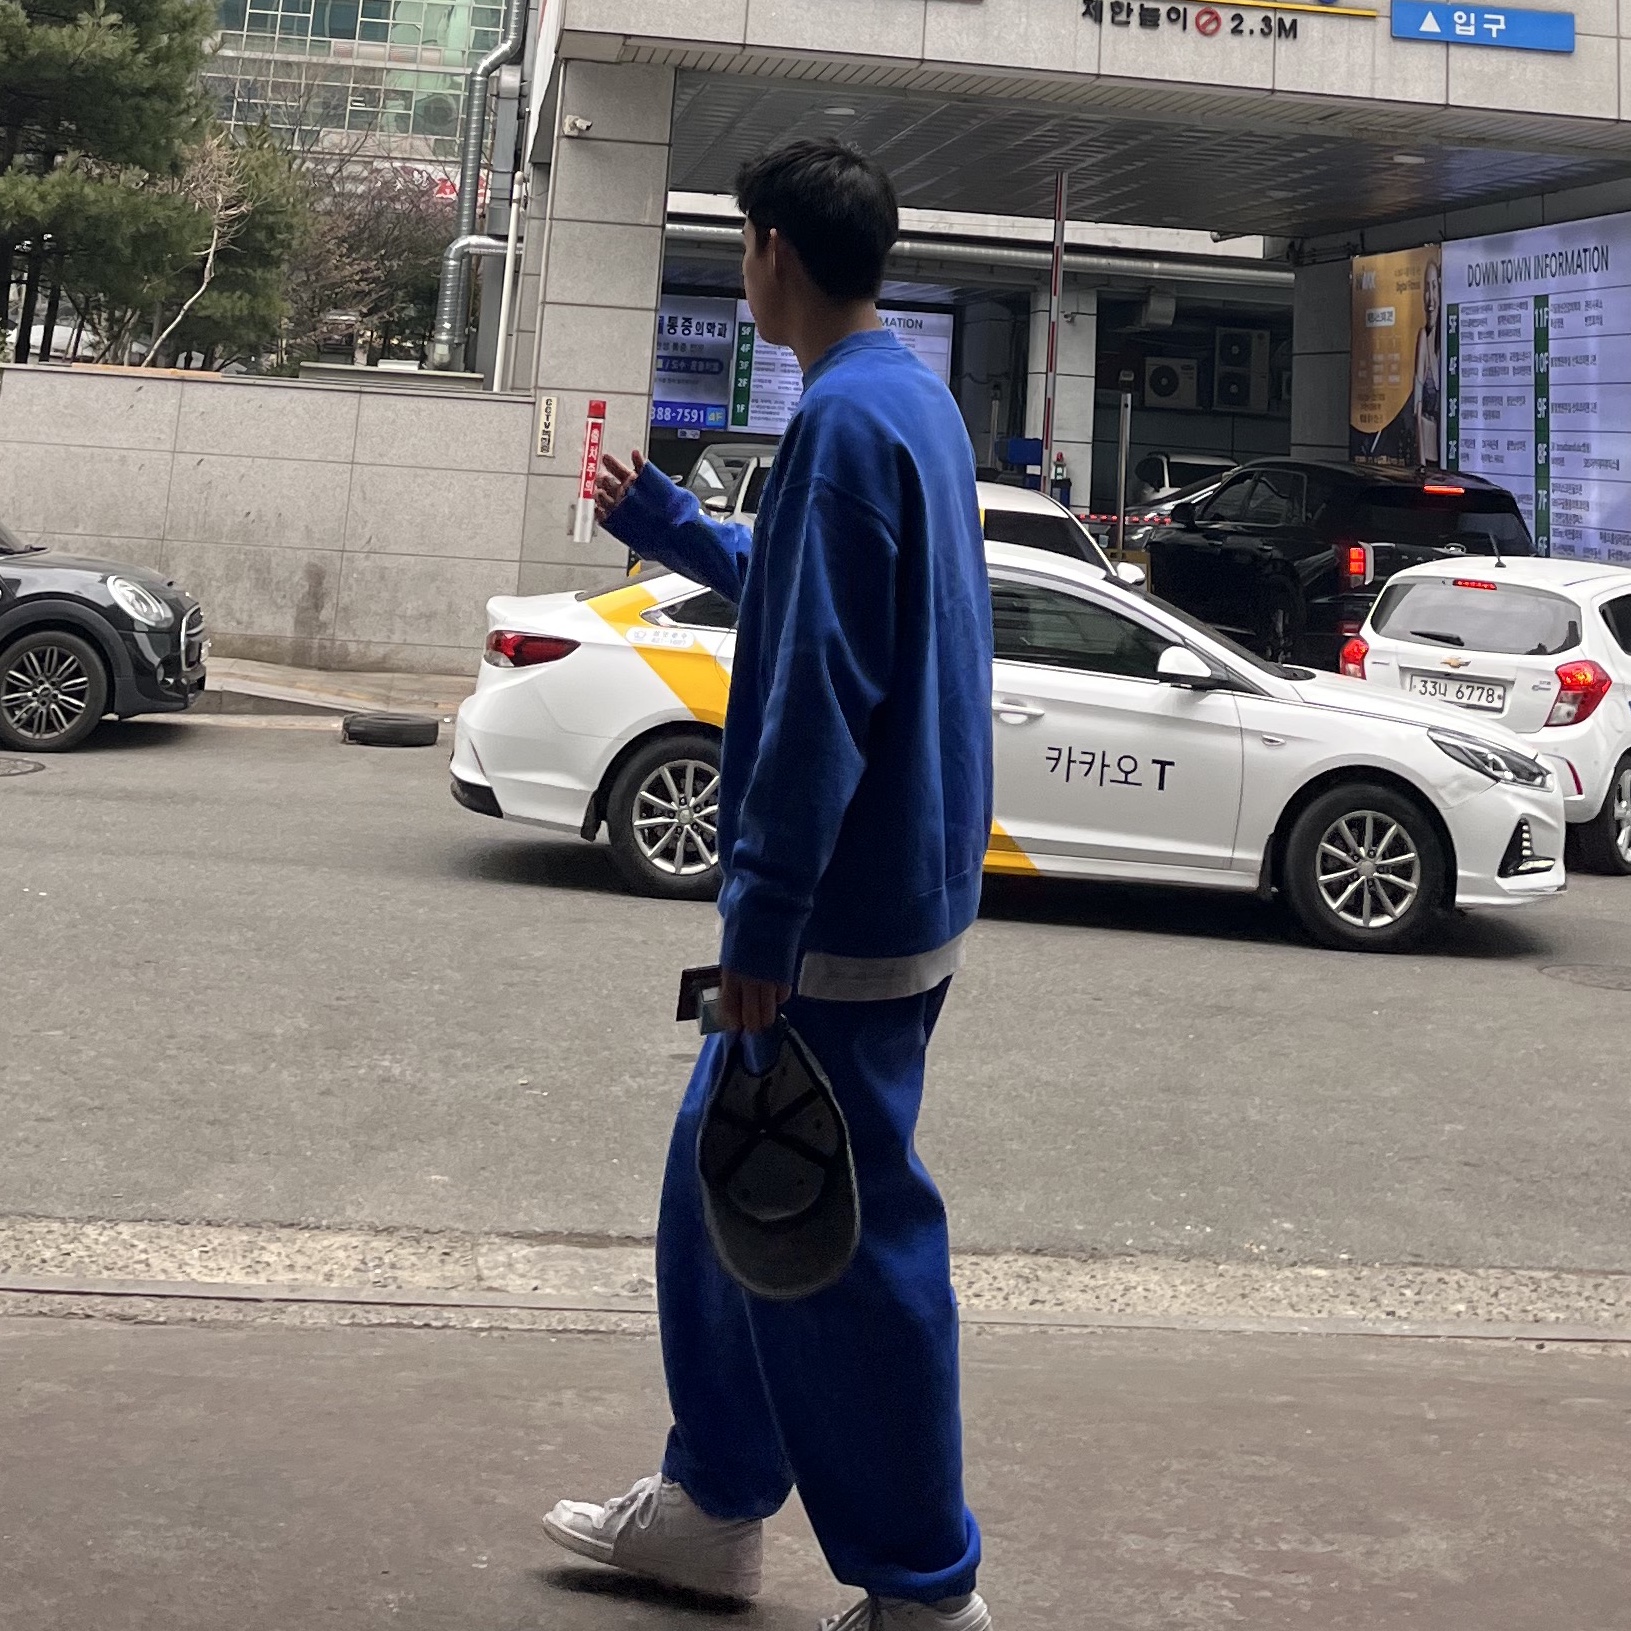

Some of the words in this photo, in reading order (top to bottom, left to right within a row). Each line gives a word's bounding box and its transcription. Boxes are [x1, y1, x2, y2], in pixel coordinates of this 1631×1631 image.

[1230, 13, 1299, 39] 2.3M
[1453, 10, 1506, 38] 입구
[1467, 260, 1498, 288] DOWN
[1501, 255, 1531, 284] TOWN
[1533, 244, 1609, 280] INFORMATION
[740, 343, 751, 353] 4F
[739, 360, 750, 370] 3F
[1535, 352, 1549, 373] 10F
[737, 378, 748, 388] 2F
[736, 403, 746, 413] 1F
[1455, 684, 1495, 704] 6778
[1046, 746, 1142, 787] 카카오
[1151, 758, 1175, 791] T
